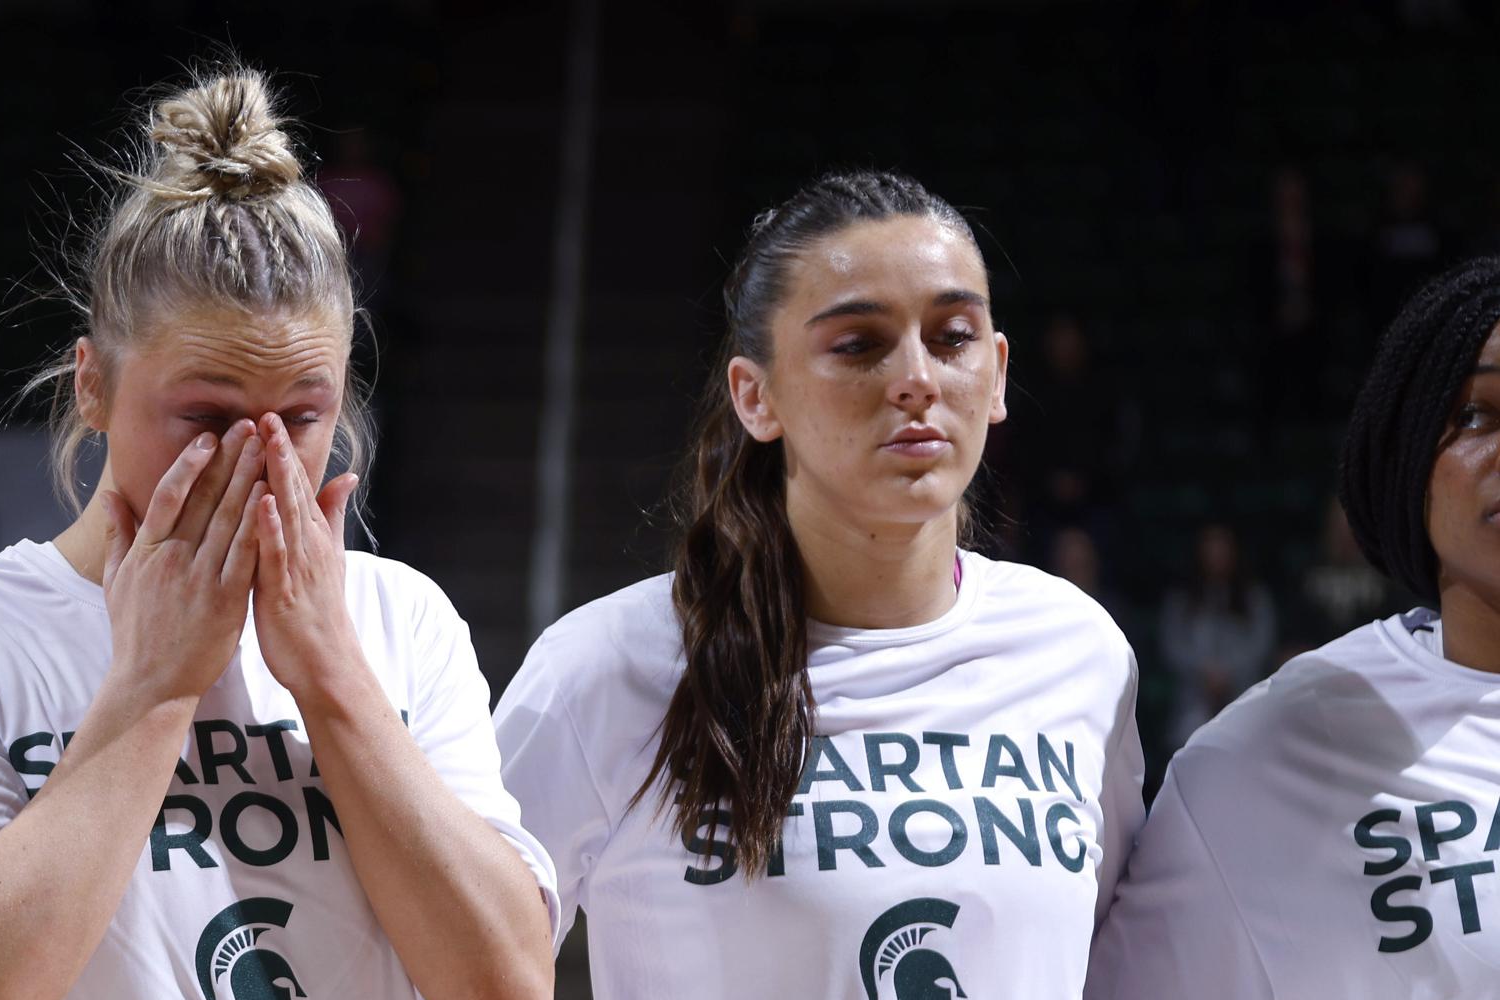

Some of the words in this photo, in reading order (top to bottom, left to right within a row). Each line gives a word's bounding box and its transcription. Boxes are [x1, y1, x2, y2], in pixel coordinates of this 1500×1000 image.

[671, 731, 1083, 803] ARTAN
[150, 783, 345, 872] RON
[1354, 796, 1500, 875] SP
